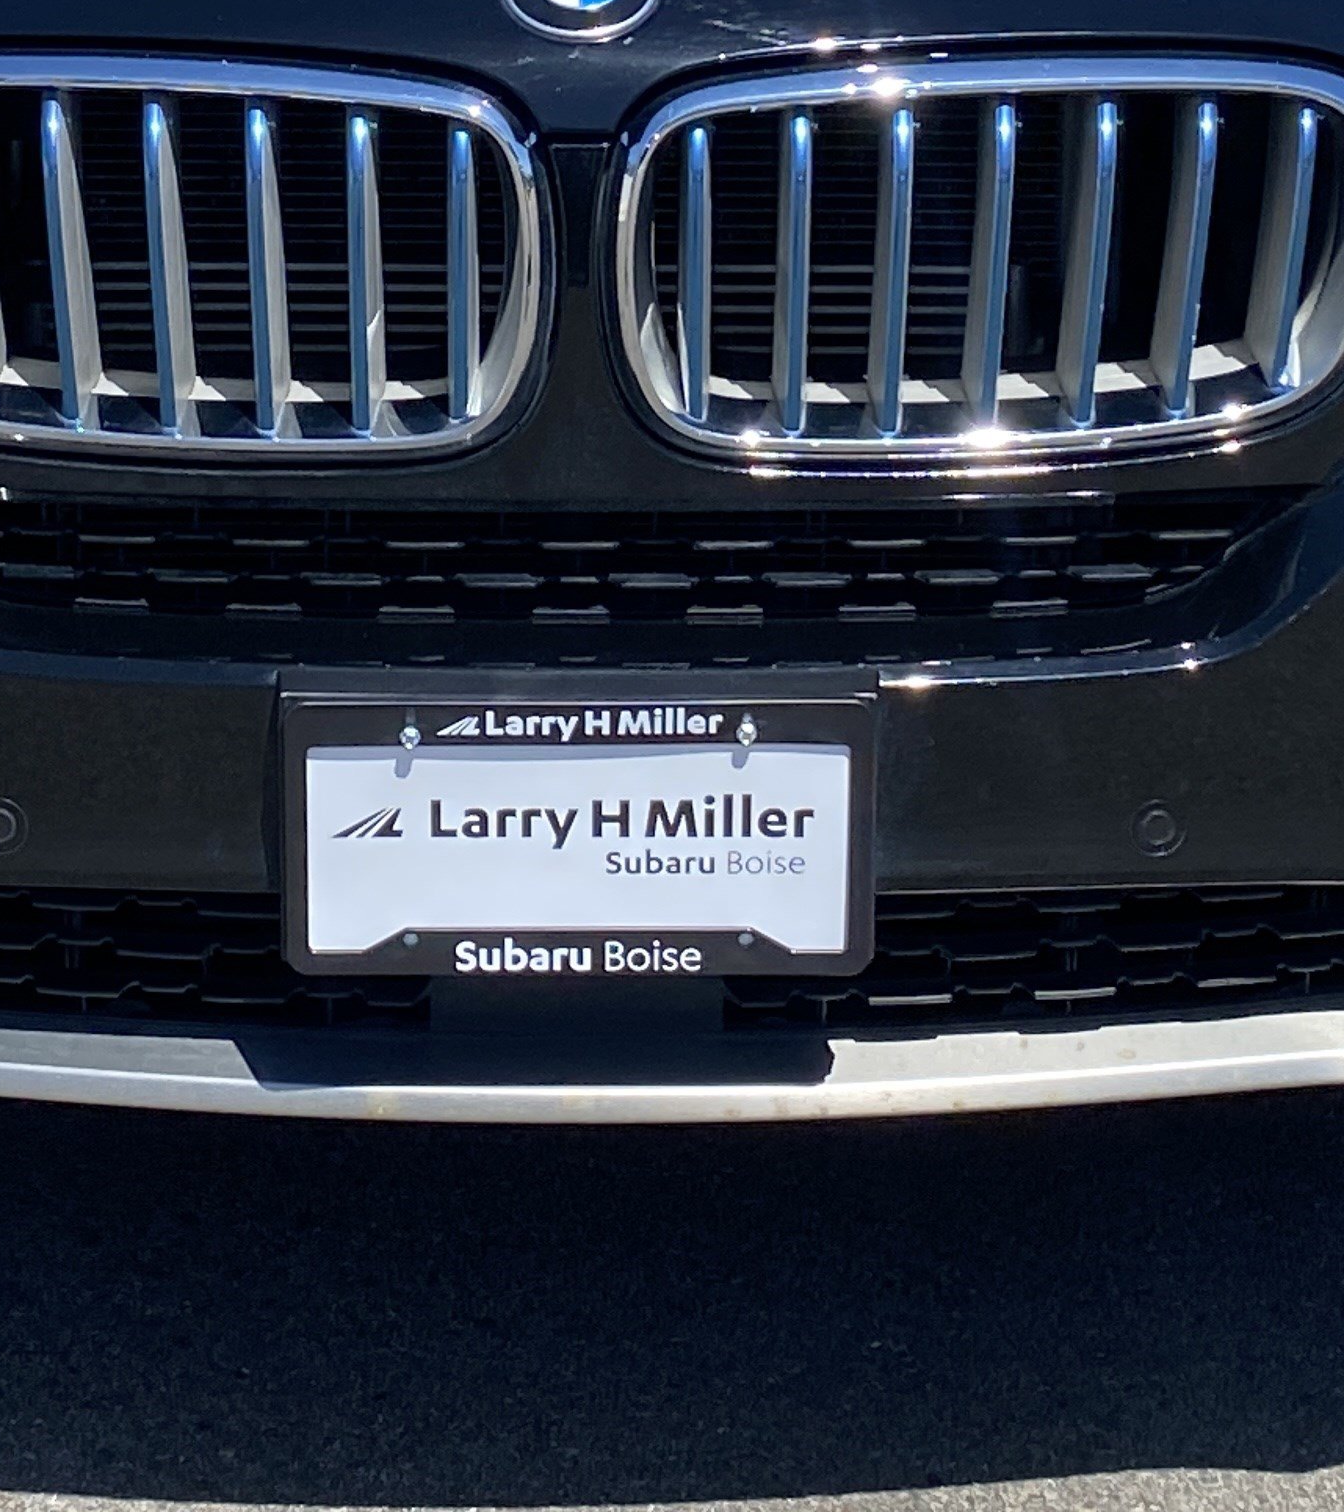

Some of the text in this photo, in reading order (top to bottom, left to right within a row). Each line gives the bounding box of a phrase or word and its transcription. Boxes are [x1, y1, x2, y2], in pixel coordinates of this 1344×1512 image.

[485, 706, 724, 742] Larry H Miller
[430, 794, 815, 850] Larry H Miller
[605, 849, 806, 875] Subaru Boise
[455, 938, 702, 973] Subaru Boise
